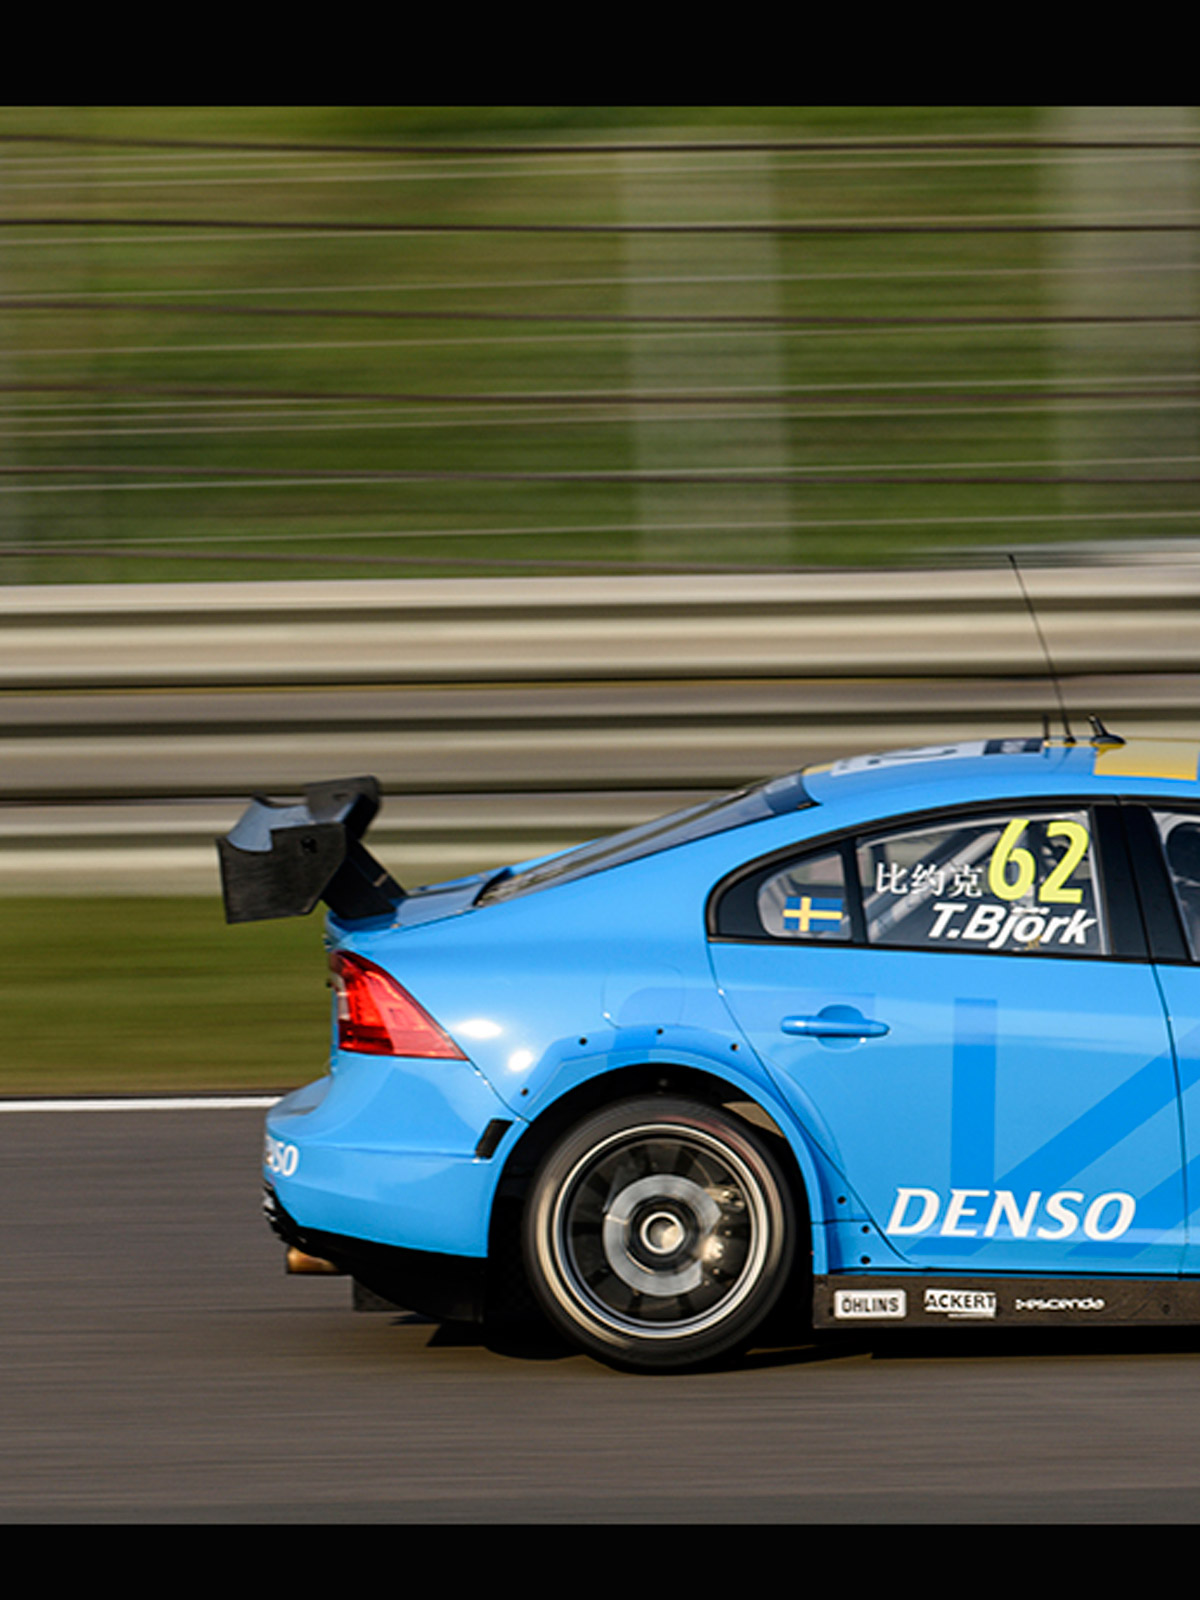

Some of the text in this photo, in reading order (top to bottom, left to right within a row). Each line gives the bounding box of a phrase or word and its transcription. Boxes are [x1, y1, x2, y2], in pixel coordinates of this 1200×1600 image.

[876, 862, 983, 898] 比约克
[988, 818, 1090, 904] 62
[928, 902, 1098, 949] T.Björk
[886, 1188, 1136, 1241] DENSO
[924, 1293, 995, 1309] ACKERT
